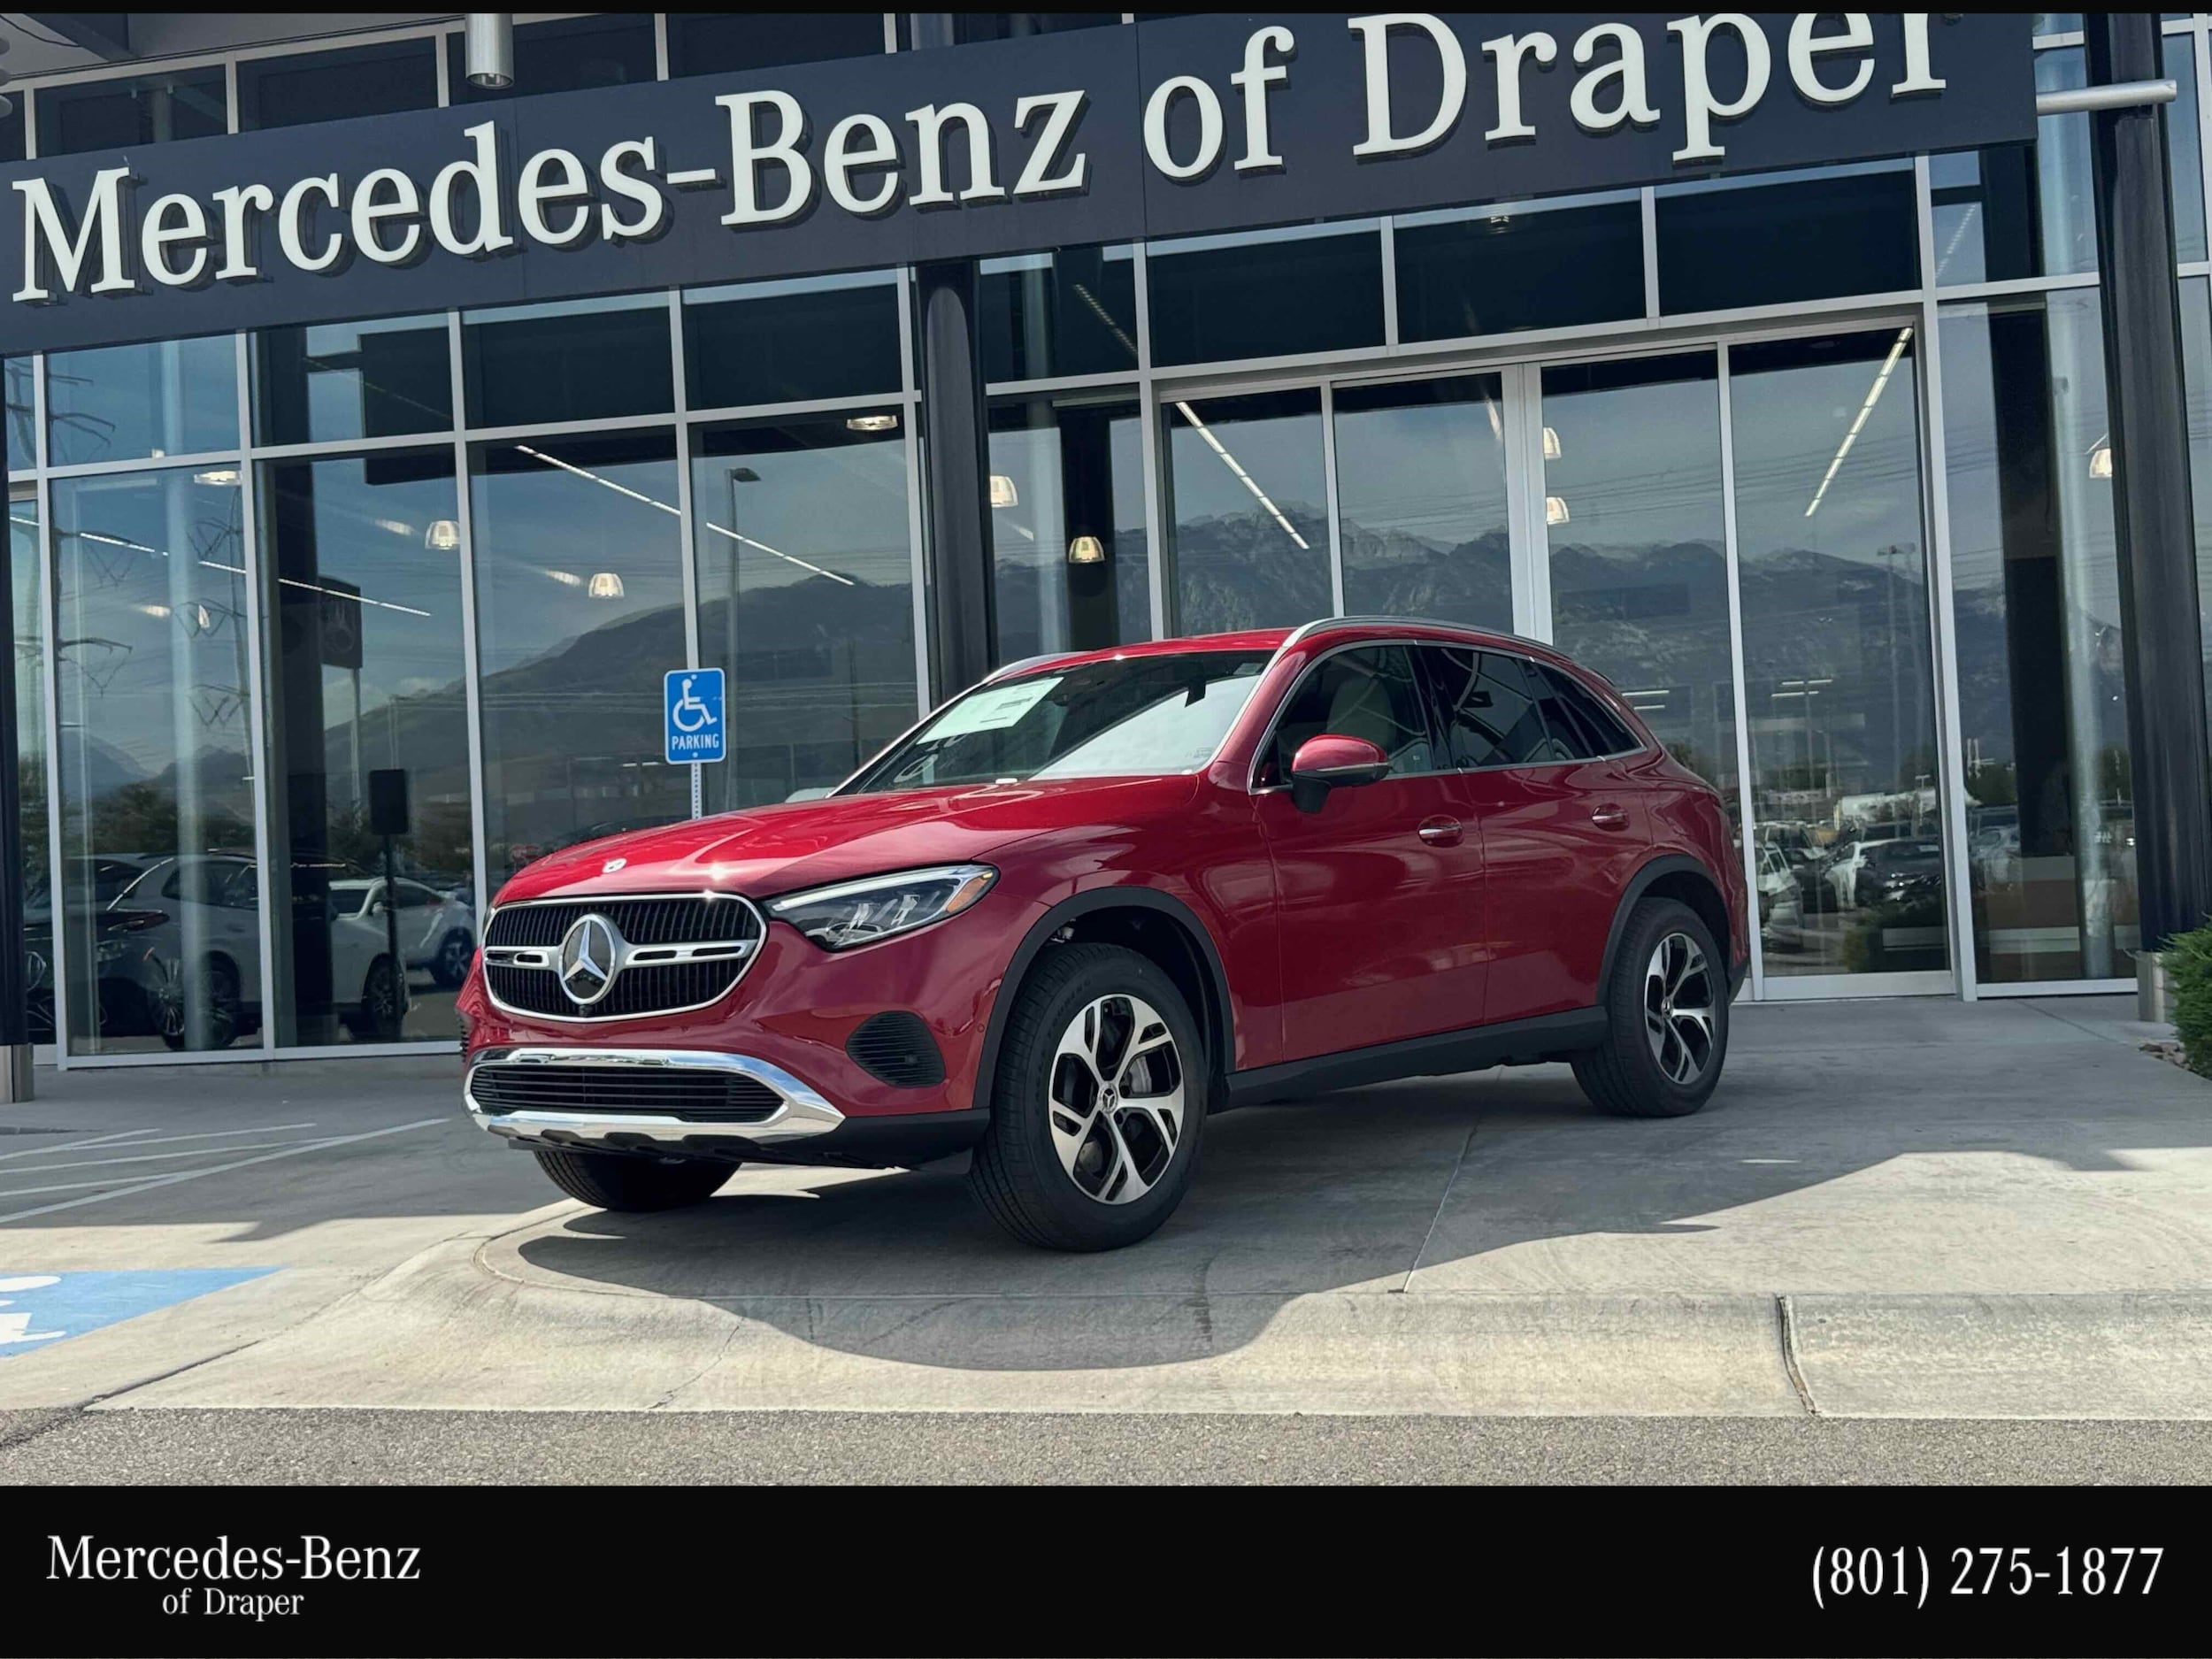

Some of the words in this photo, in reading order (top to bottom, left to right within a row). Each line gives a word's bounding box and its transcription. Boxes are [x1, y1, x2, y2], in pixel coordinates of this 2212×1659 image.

[12, 89, 1086, 303] Mercedes-Benz
[1143, 26, 1295, 179] of
[1348, 13, 1947, 163] Draper
[672, 733, 719, 750] PARKING
